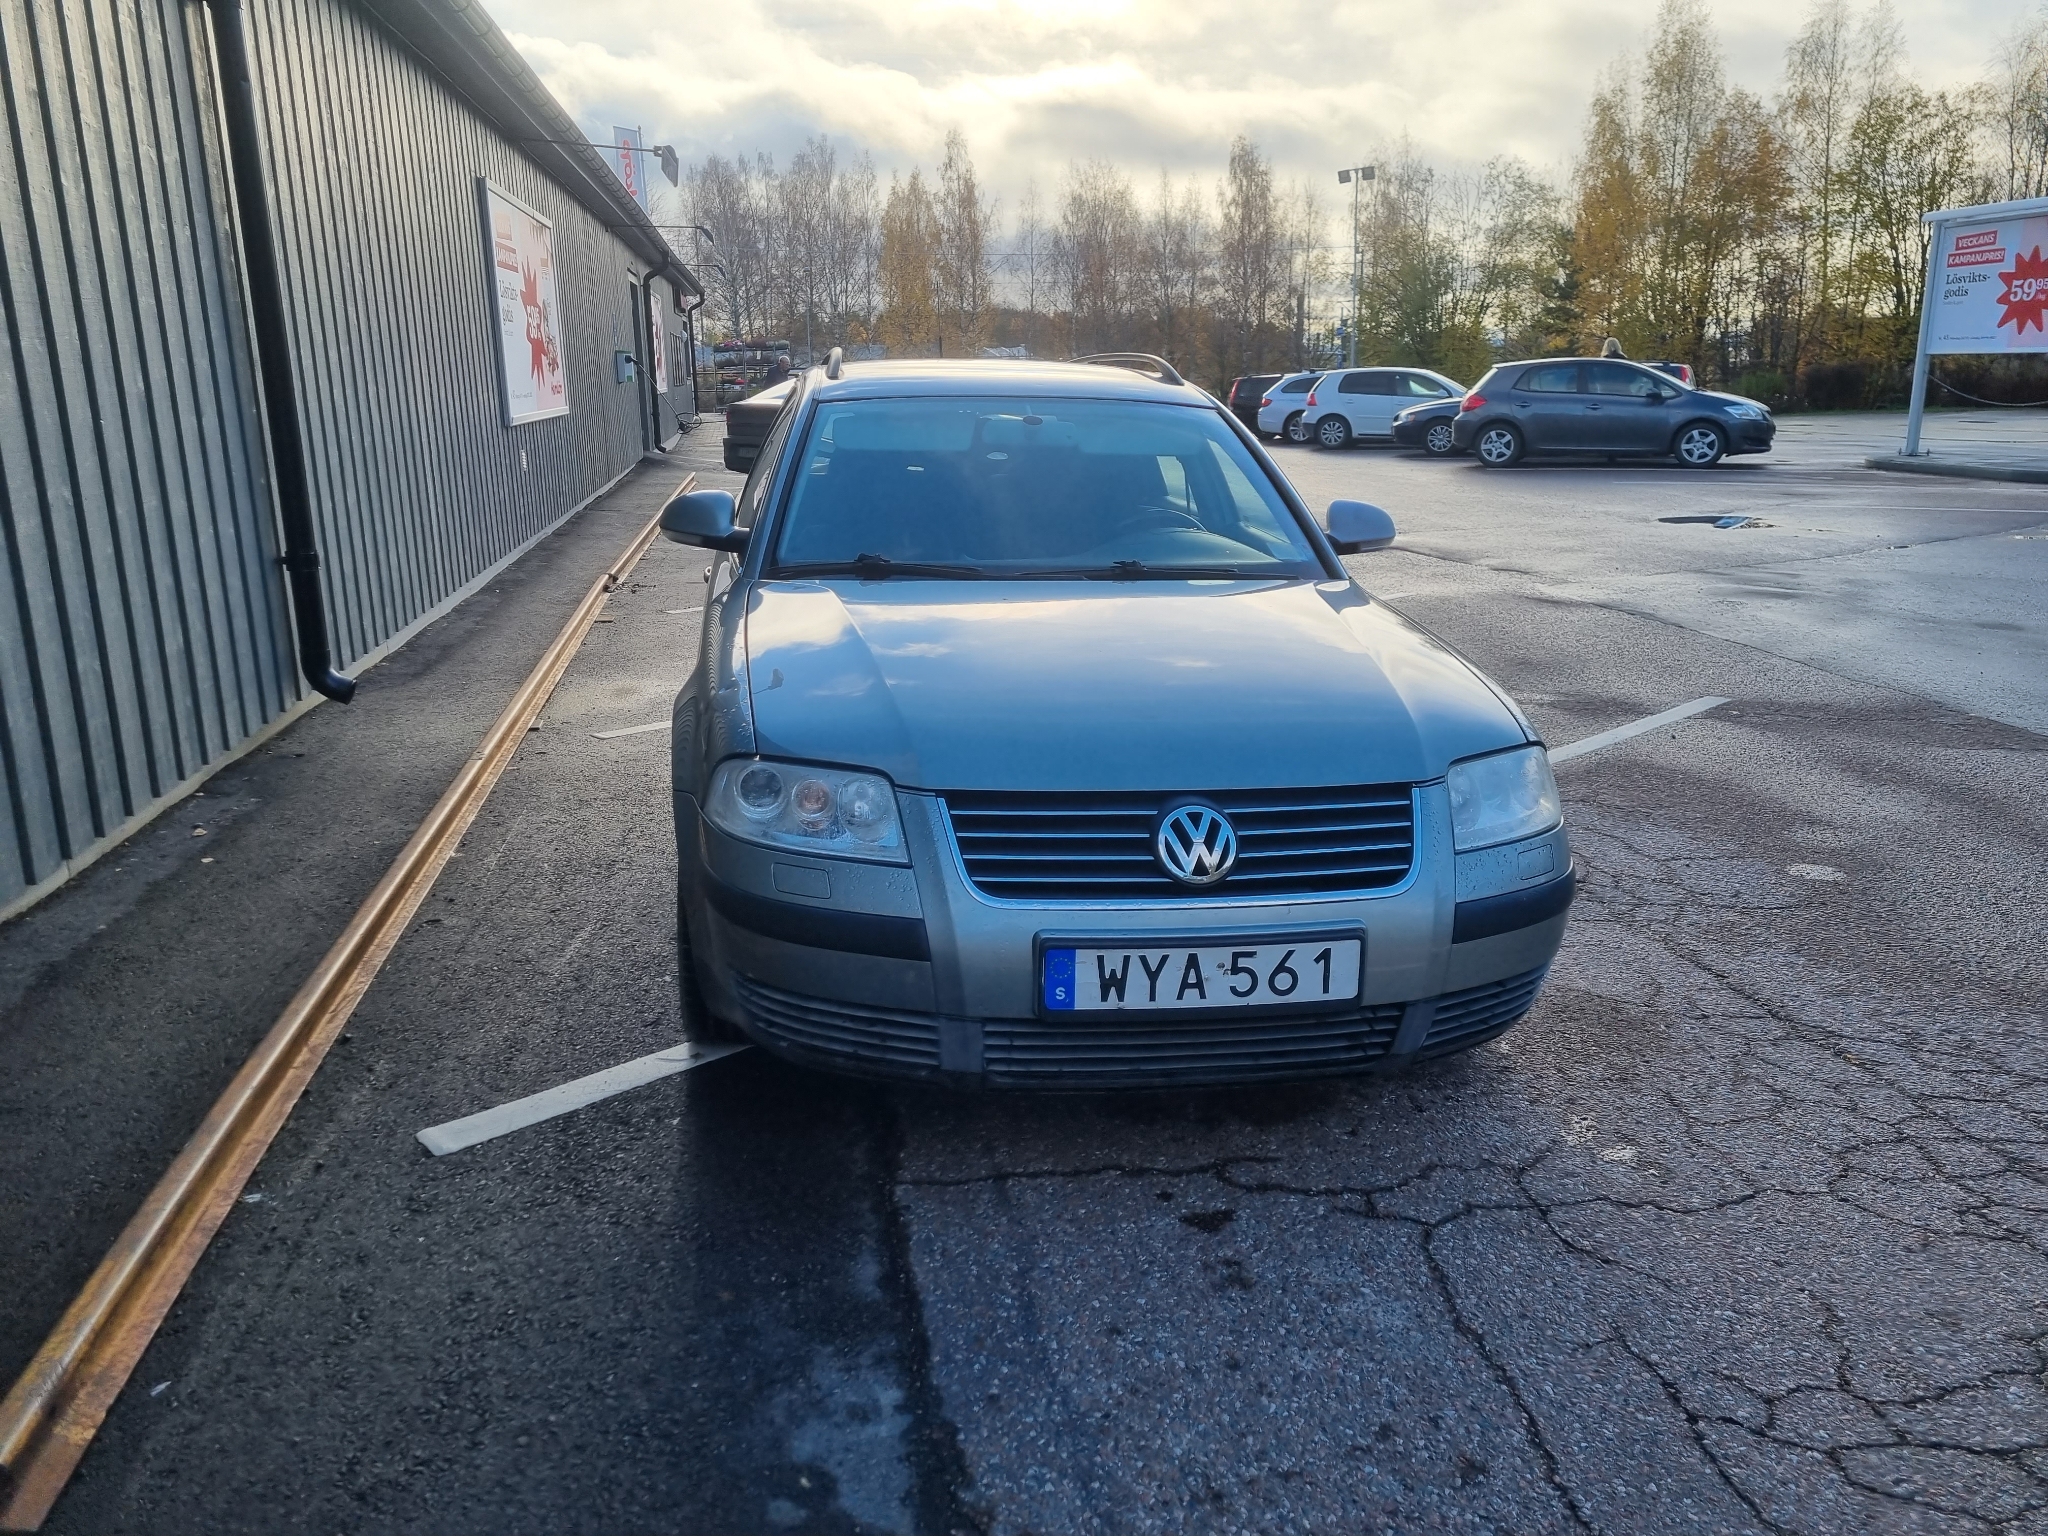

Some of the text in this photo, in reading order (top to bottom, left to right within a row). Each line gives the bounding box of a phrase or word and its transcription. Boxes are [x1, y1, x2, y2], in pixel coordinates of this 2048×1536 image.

[1958, 233, 1996, 248] VECKANS
[1948, 250, 2004, 266] KAMPANJPRIS!
[1945, 272, 1991, 285] Lösvikts-
[1943, 285, 1969, 300] godis
[1096, 947, 1333, 1003] WYA 561
[1055, 986, 1066, 1000] S
